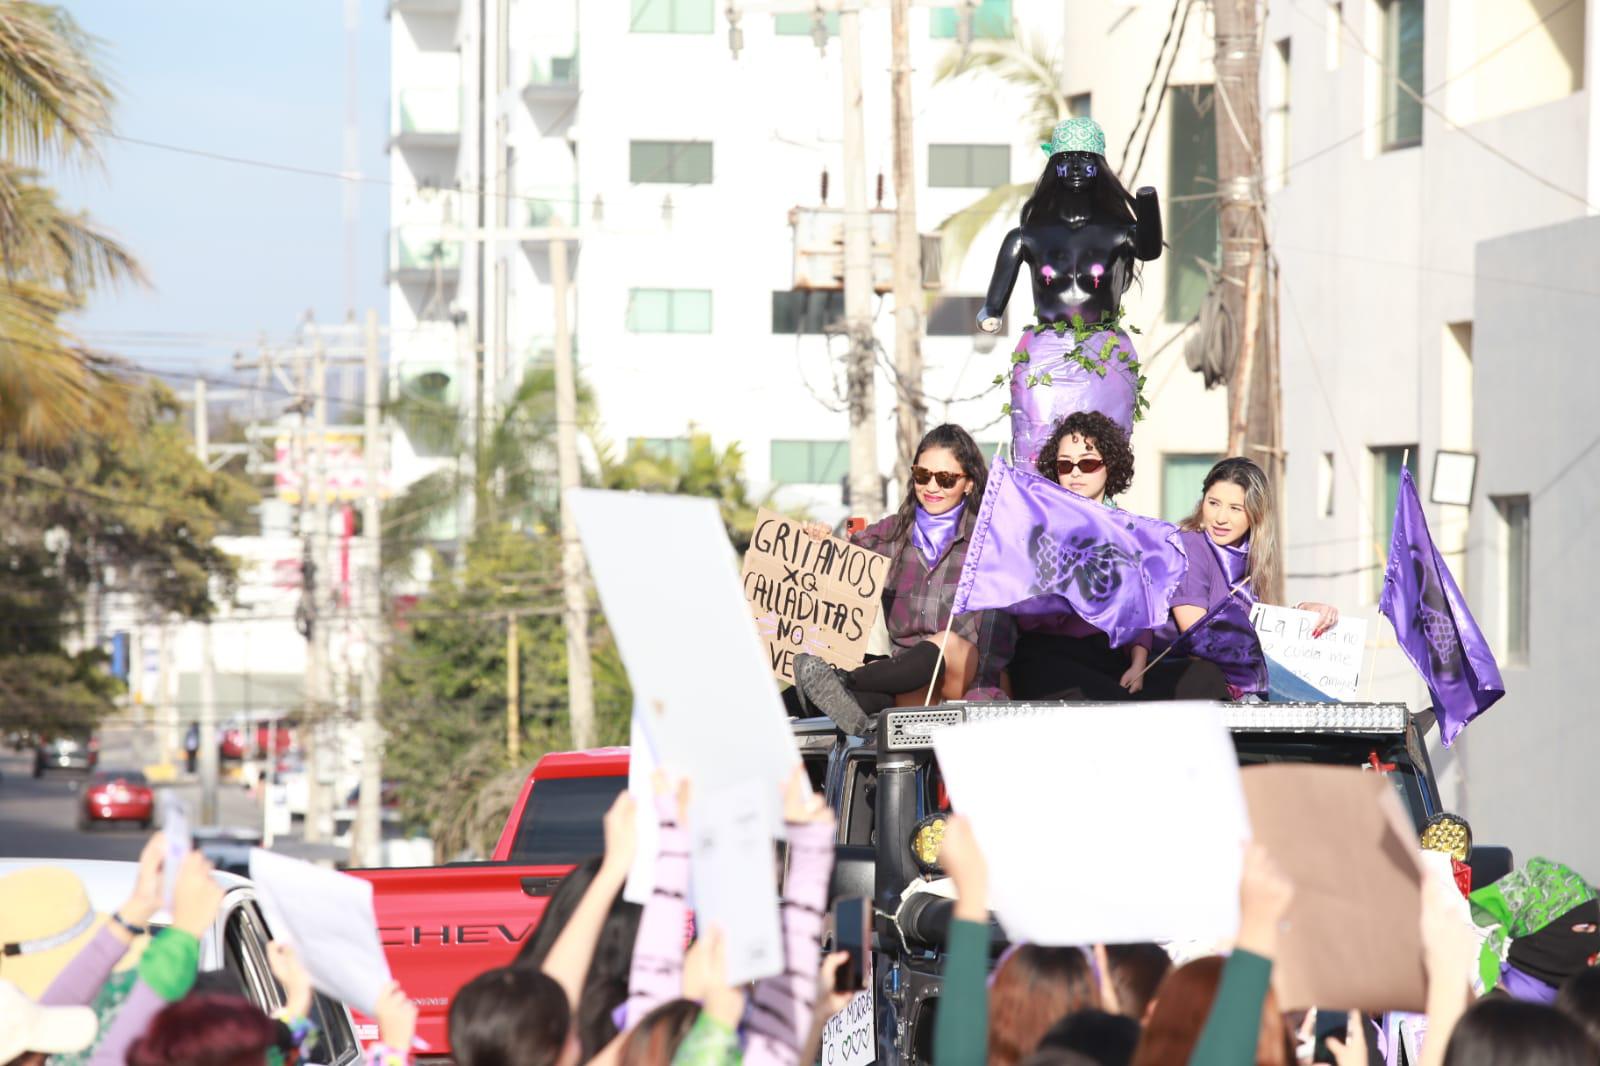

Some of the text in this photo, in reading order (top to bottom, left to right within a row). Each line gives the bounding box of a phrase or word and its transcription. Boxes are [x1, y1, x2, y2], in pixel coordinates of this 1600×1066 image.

[755, 519, 884, 598] GRITAMOS
[744, 571, 864, 641] CALLADITAS
[777, 617, 804, 646] NO
[823, 1009, 844, 1044] ENTRE
